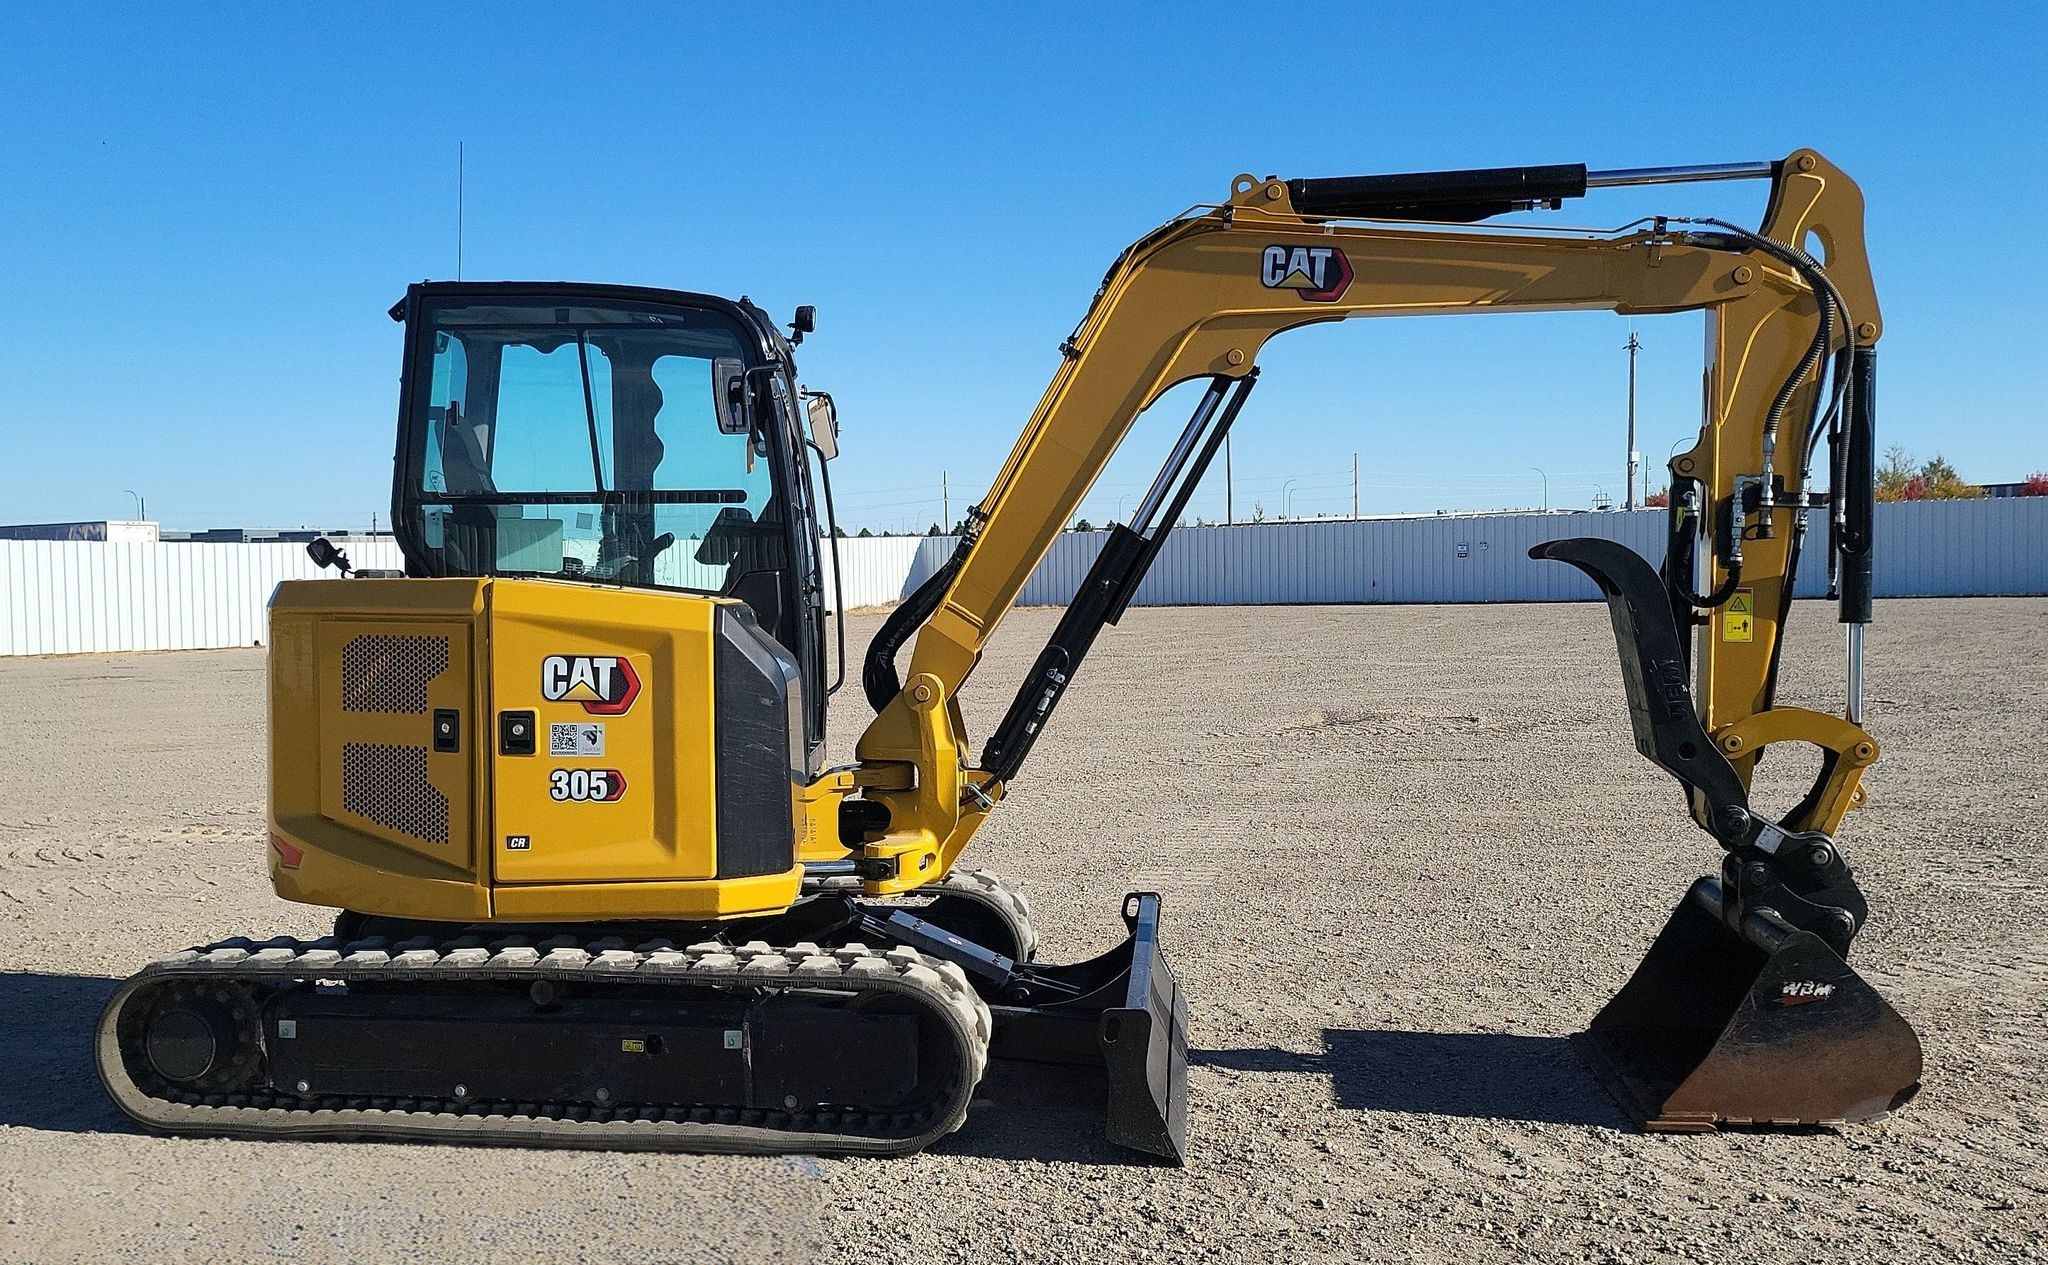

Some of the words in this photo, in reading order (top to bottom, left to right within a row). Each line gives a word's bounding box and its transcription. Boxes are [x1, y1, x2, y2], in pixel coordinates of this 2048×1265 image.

[1263, 246, 1332, 289] CAT
[544, 656, 616, 700] CAT
[551, 770, 607, 800] 305
[510, 837, 526, 848] CR
